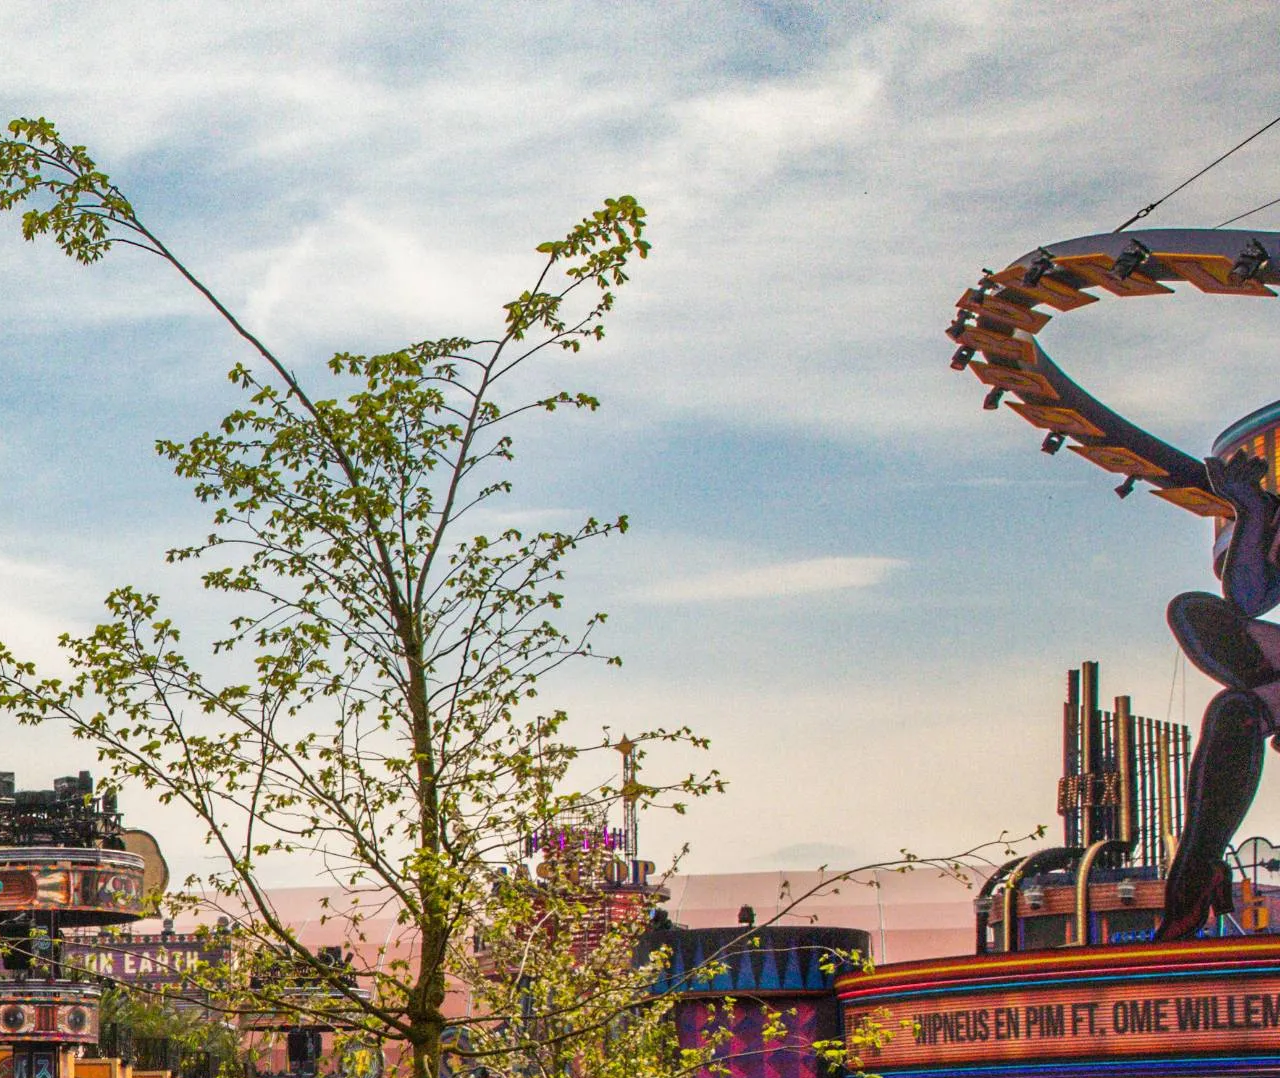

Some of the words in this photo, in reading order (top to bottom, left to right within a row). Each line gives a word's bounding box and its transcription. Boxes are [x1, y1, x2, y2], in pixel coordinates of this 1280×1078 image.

[995, 1006, 1021, 1040] EN
[1026, 1003, 1065, 1039] PIM
[1072, 1001, 1106, 1037] FT.
[1113, 998, 1170, 1035] OME
